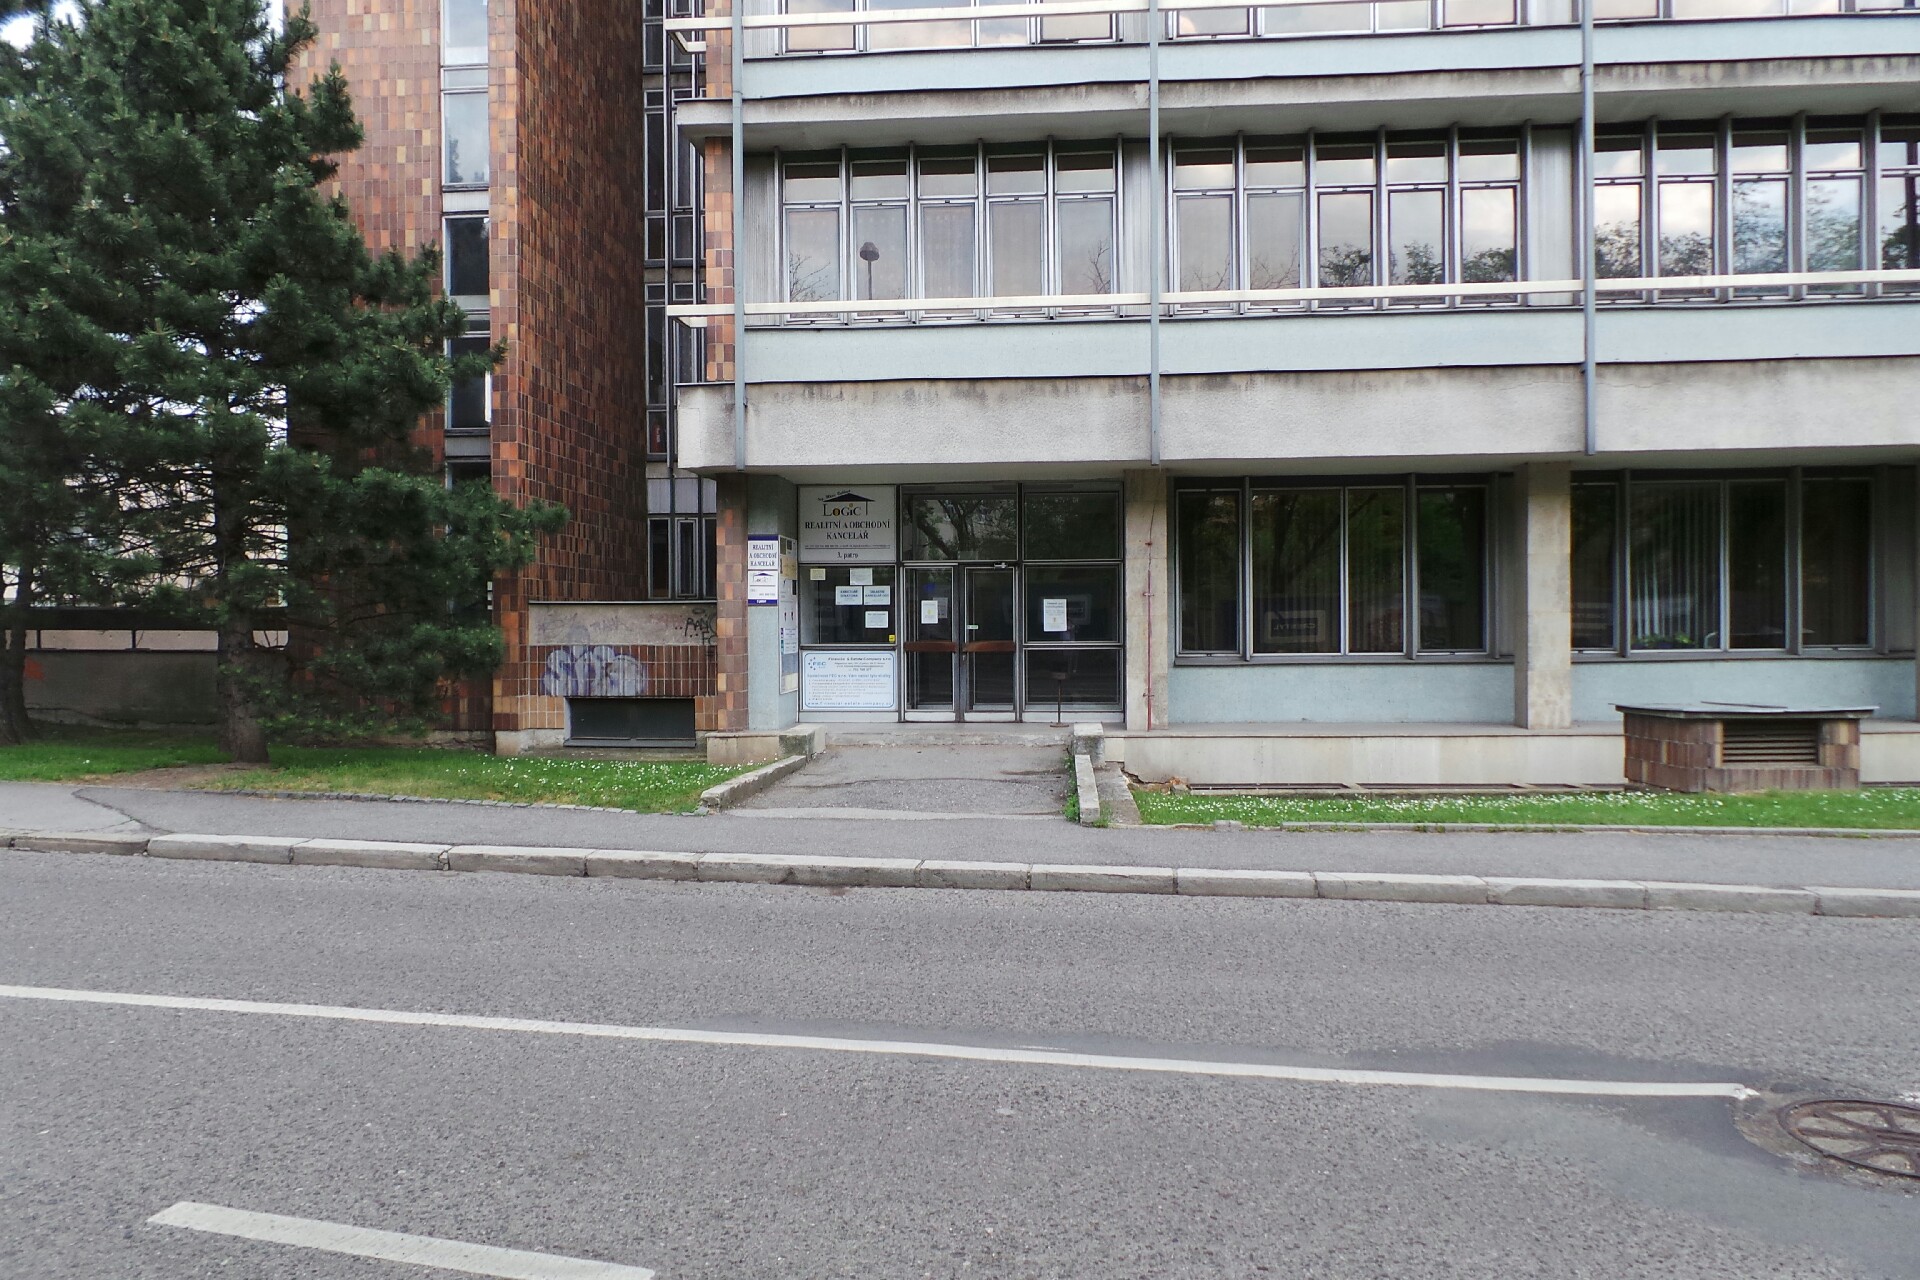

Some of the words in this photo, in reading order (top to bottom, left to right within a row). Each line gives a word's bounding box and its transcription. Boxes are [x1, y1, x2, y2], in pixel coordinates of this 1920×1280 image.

[804, 519, 841, 529] REALITNÍ
[843, 521, 849, 529] A
[849, 519, 890, 529] OBCHODNÍ
[826, 530, 869, 540] KANCELÁŘ
[752, 543, 774, 551] REALITNÍ
[843, 552, 859, 560] patro
